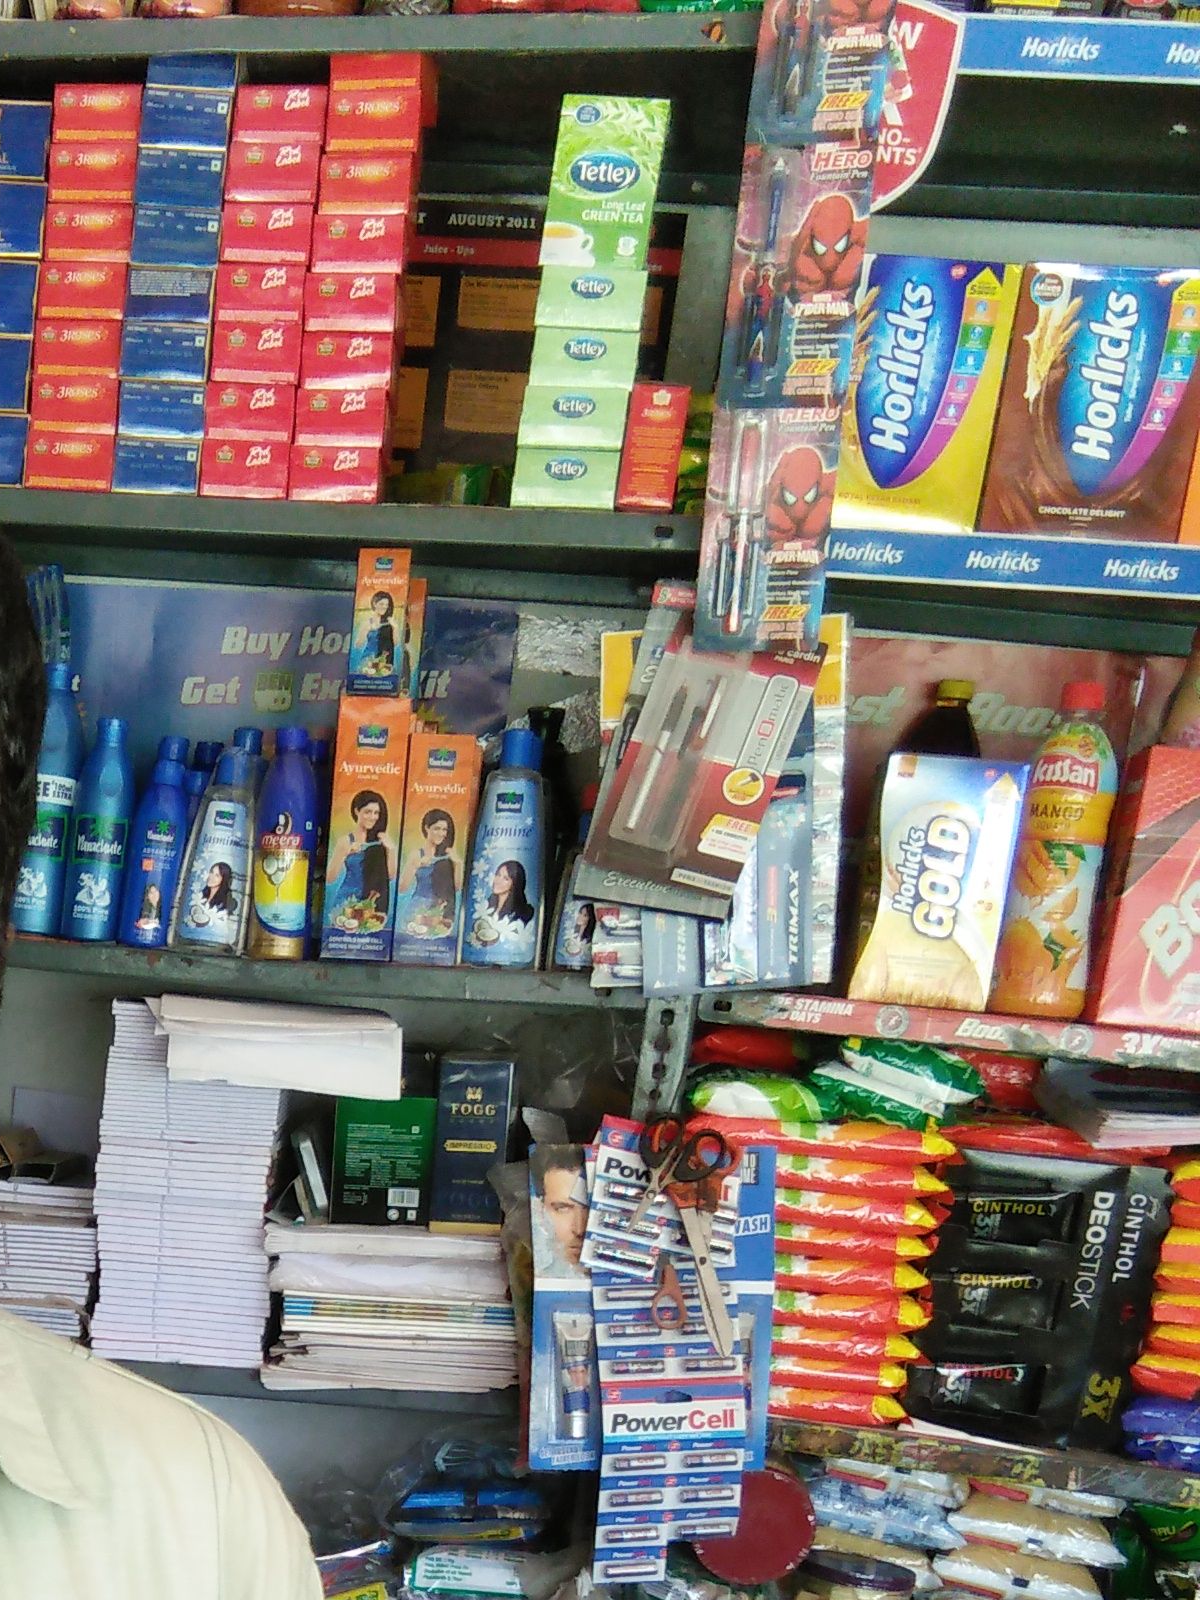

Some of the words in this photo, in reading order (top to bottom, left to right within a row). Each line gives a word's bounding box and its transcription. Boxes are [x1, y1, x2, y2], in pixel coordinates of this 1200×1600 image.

[1021, 36, 1101, 62] Horlicks
[812, 150, 873, 171] HERO
[577, 160, 636, 189] Tetley
[581, 210, 620, 223] GREEN
[622, 212, 644, 224] TEA
[626, 202, 646, 213] Leaf
[447, 212, 504, 227] AUGUST
[506, 216, 537, 230] 2011
[574, 278, 614, 297] Tetley
[567, 340, 606, 358] Tetley
[869, 281, 934, 454] Horlicks
[1072, 289, 1139, 461] Horlicks
[556, 398, 595, 415] Tetley
[548, 459, 586, 478] Tetley
[1038, 504, 1088, 517] CHOCOLATE
[1089, 507, 1126, 518] DELIGHT
[832, 541, 904, 566] Horlicks
[965, 550, 1041, 574] Horlicks
[1103, 558, 1180, 583] Horlicks
[221, 626, 292, 661] Buy
[181, 675, 241, 705] Get
[339, 760, 401, 777] Ayurvedic
[411, 782, 467, 796] Ayurvedic
[1029, 803, 1085, 822] MANGO
[262, 835, 300, 846] meera
[482, 823, 534, 841] Jasmine
[77, 833, 123, 856] Parachute
[892, 826, 926, 915] Horlicks
[912, 815, 971, 940] GOLD
[603, 870, 670, 895] Executive
[787, 868, 800, 965] TRIMAX
[794, 998, 856, 1018] STAMINA
[451, 1103, 497, 1116] FOGG
[972, 1199, 1047, 1216] CINTHOL
[1111, 1193, 1148, 1284] CINTHOL
[1070, 1191, 1116, 1311] DEOSTICK
[960, 1273, 1033, 1289] CINTHOL
[1080, 1372, 1122, 1424] 3X
[610, 1407, 735, 1434] PowerCell
